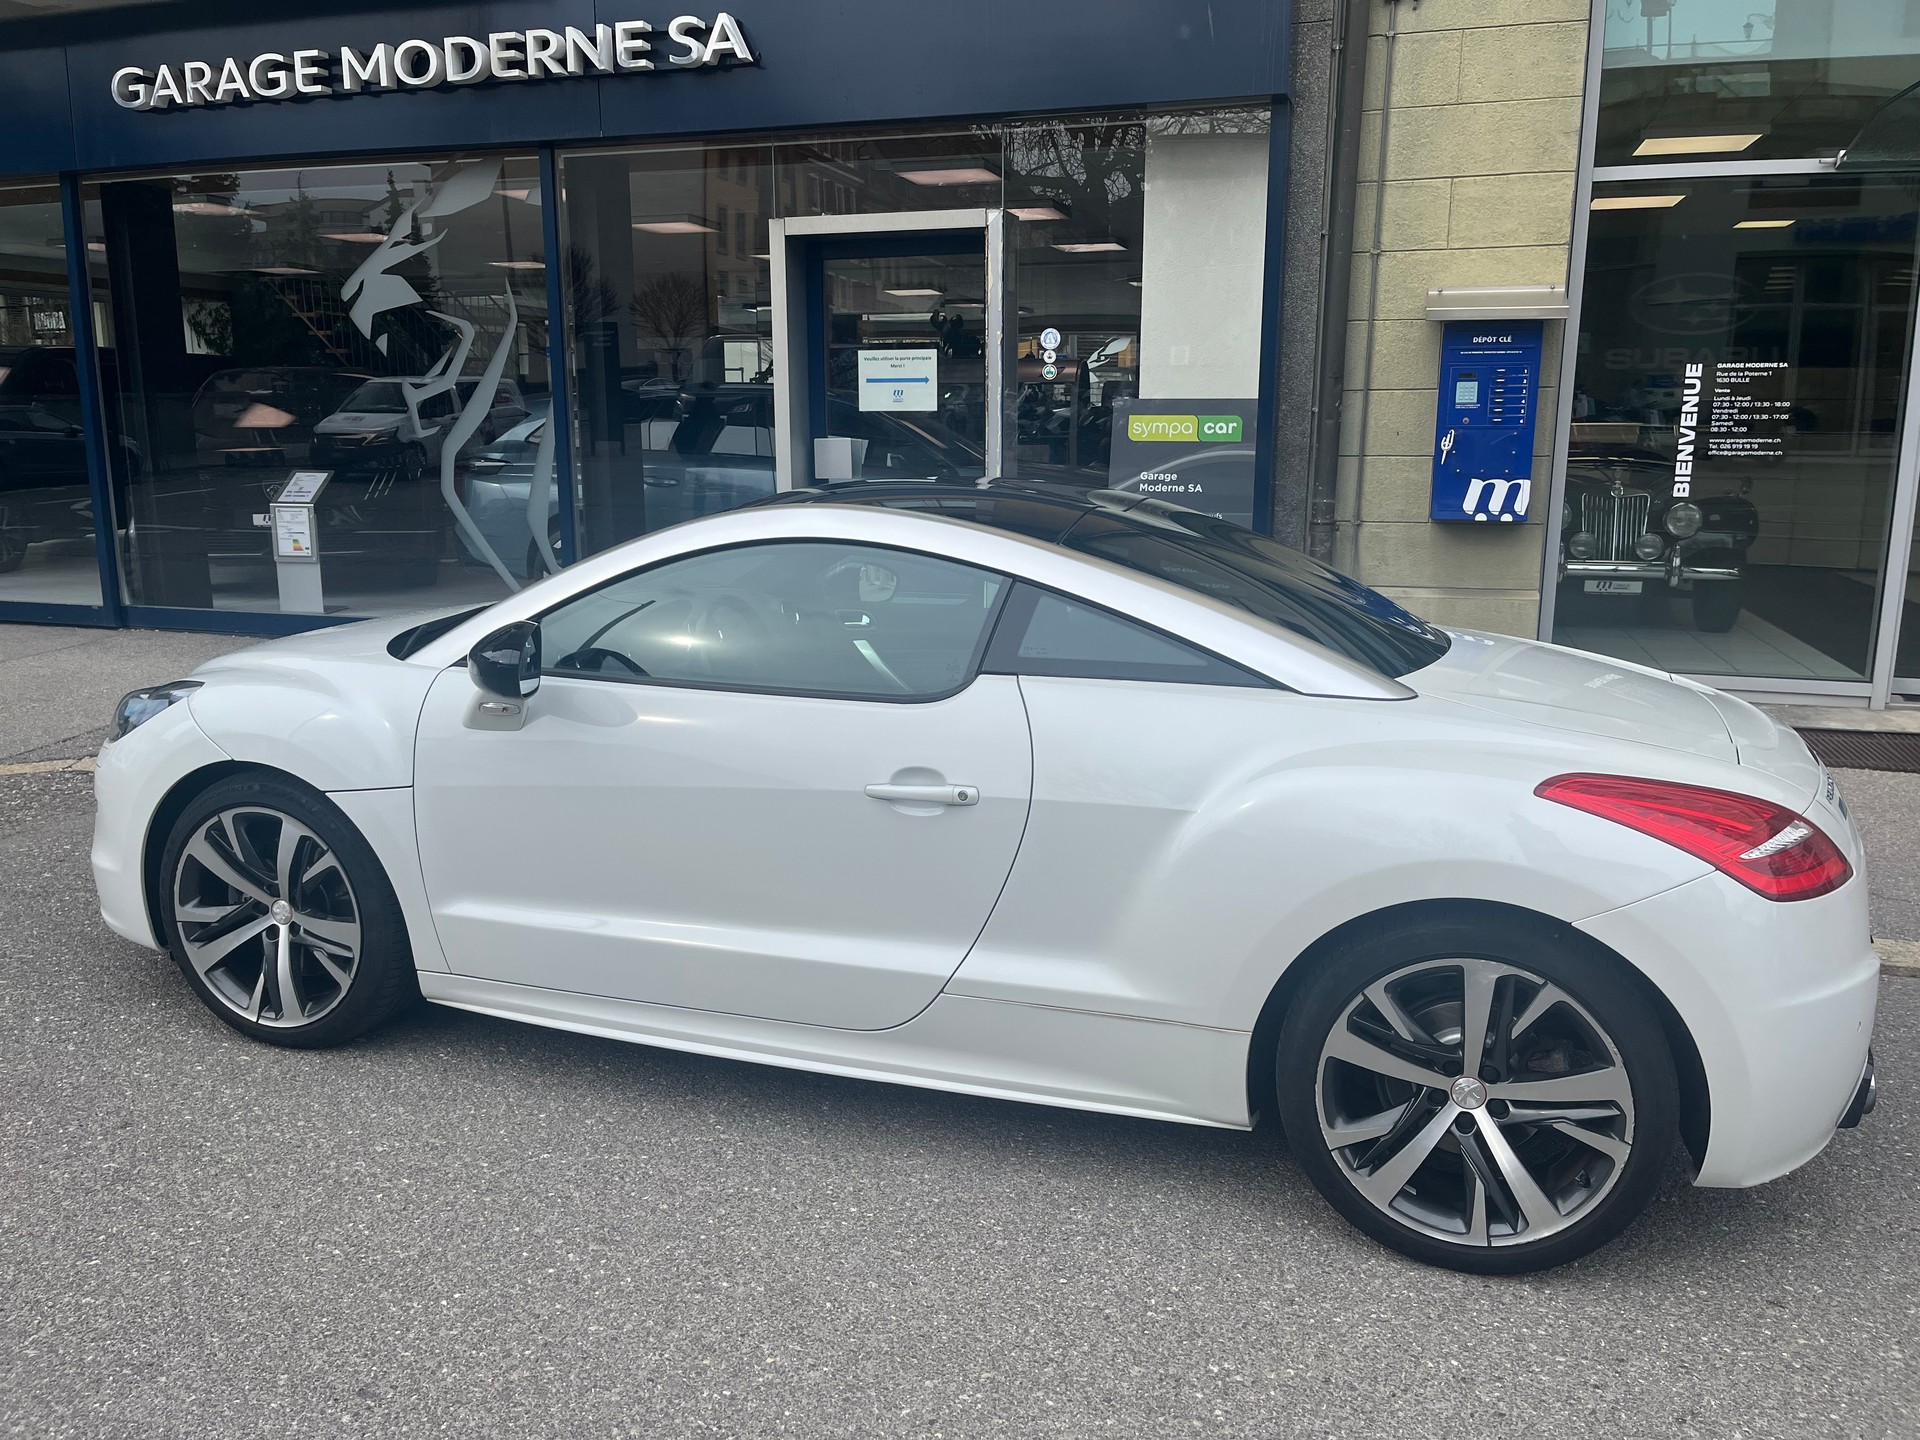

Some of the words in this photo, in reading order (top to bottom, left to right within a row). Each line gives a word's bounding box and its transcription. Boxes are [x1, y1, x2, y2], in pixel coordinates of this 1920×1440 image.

[111, 49, 332, 110] GARAGE
[340, 20, 653, 90] MODERNE
[668, 12, 754, 68] SA
[1472, 335, 1497, 343] DÉPÔT
[1498, 335, 1512, 343] CLÉ
[1132, 422, 1193, 438] sympa
[1203, 422, 1237, 434] car
[1672, 363, 1703, 498] BIENVENUE
[1140, 472, 1178, 482] Garage
[1139, 483, 1185, 492] Moderne
[1188, 484, 1203, 493] SA
